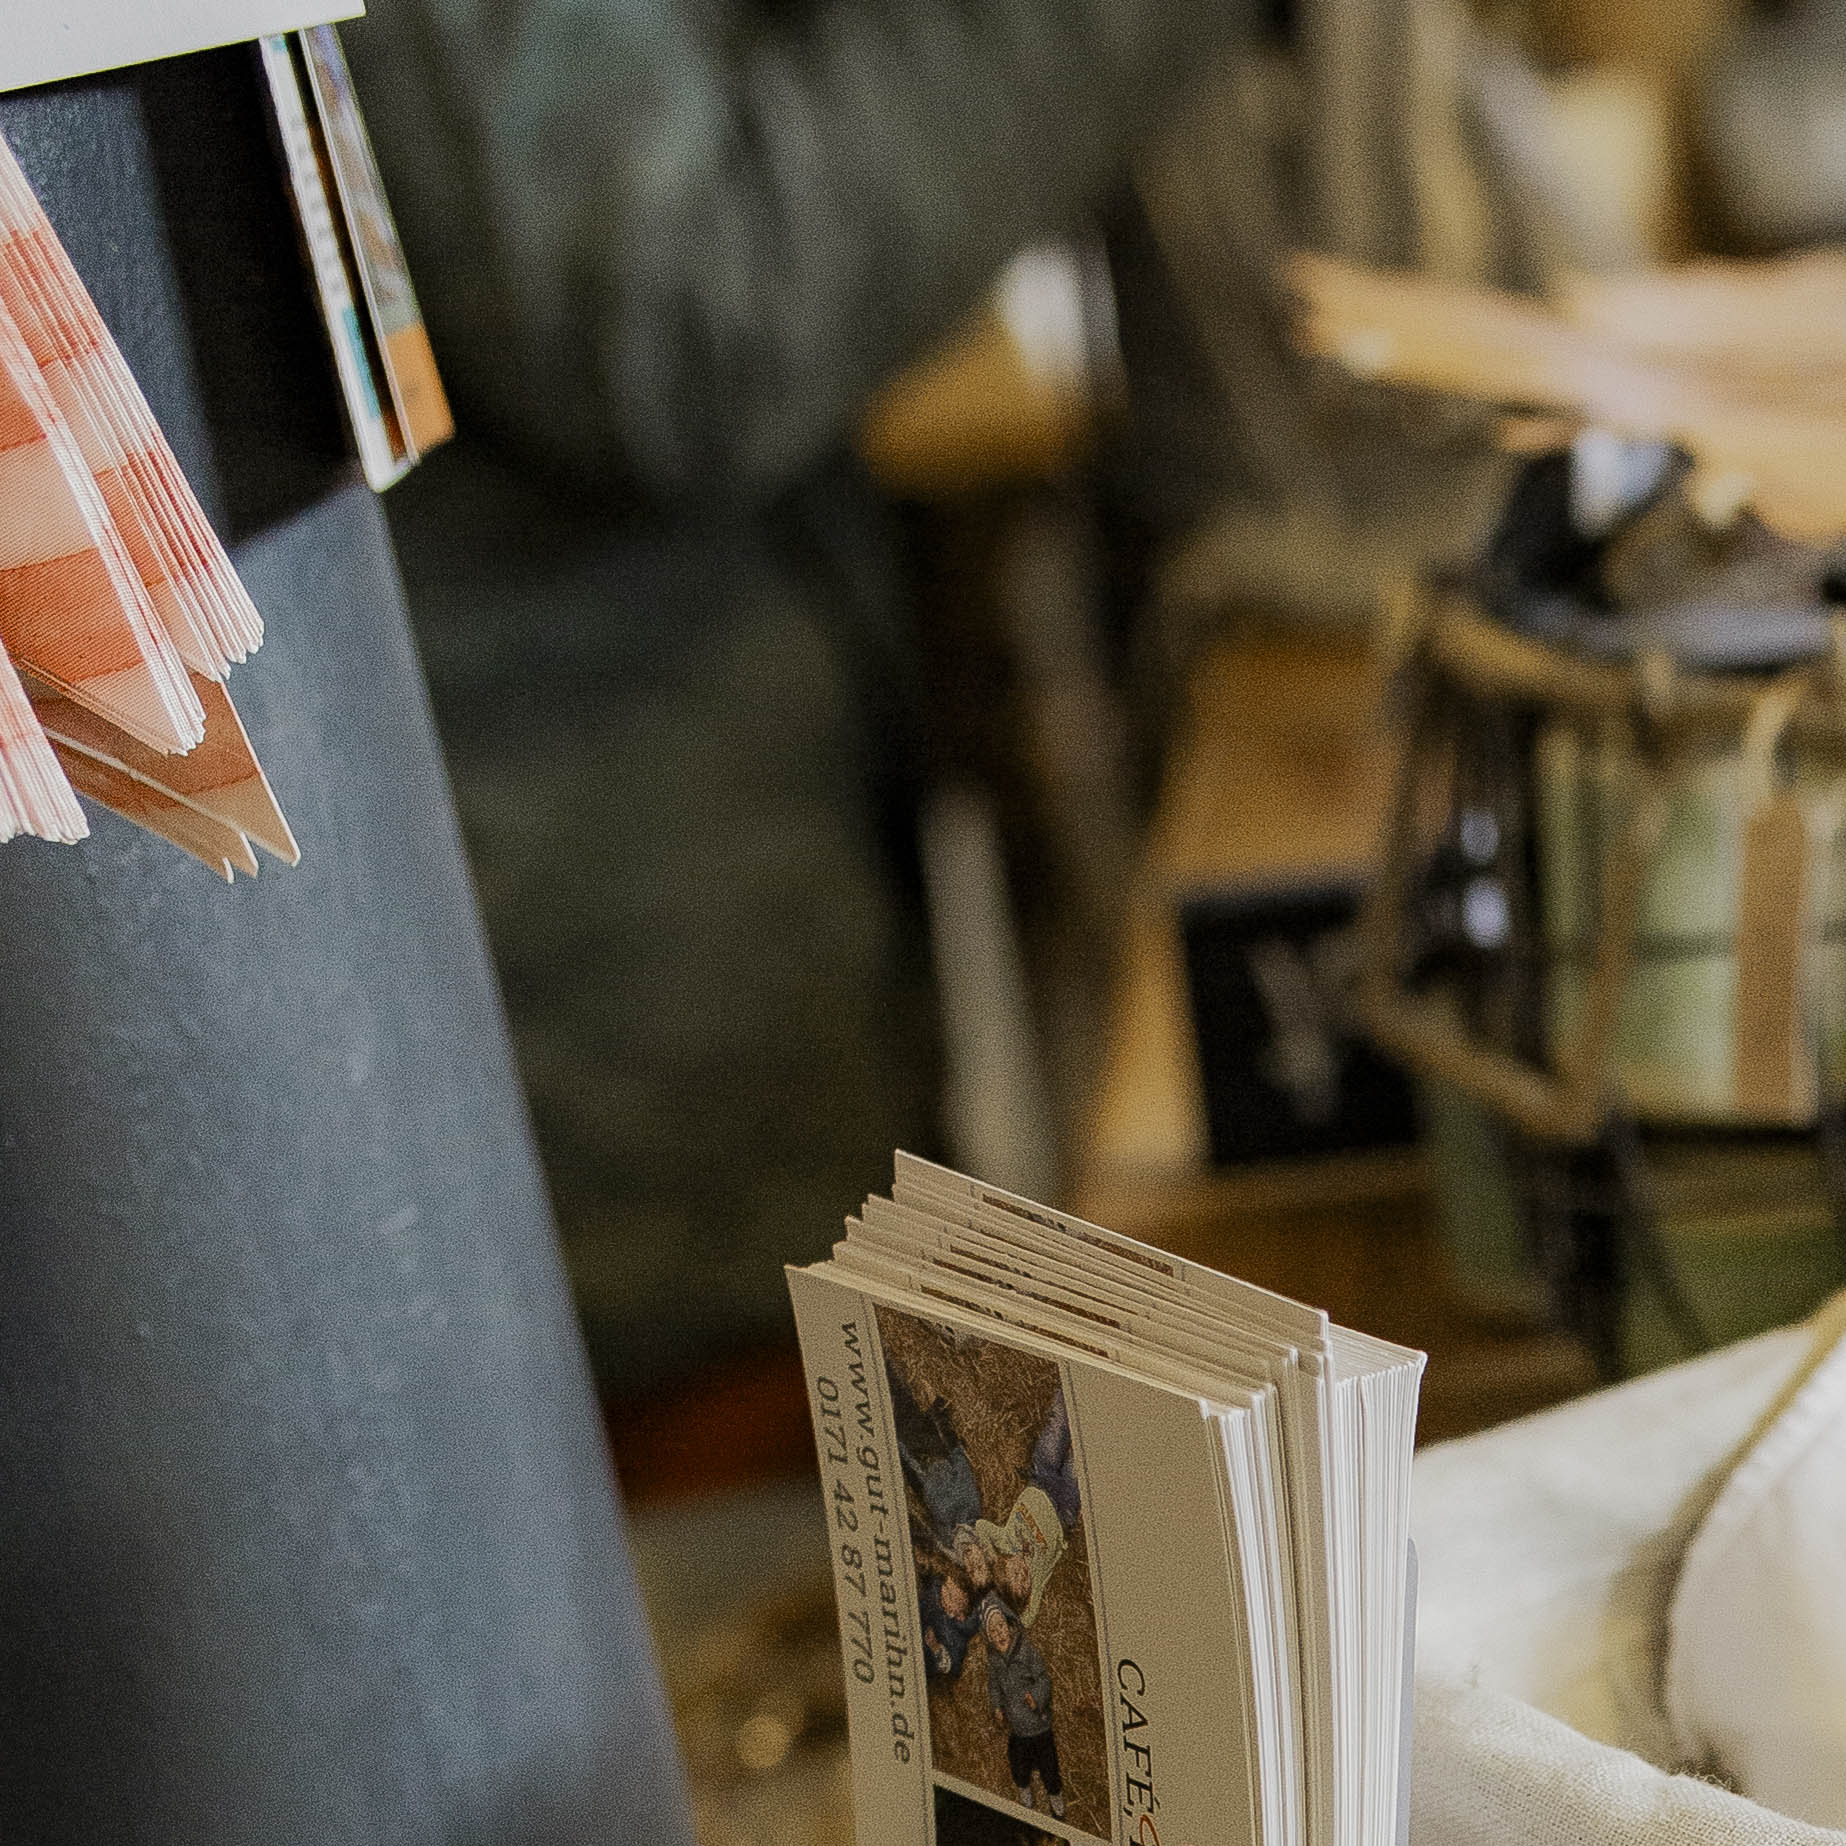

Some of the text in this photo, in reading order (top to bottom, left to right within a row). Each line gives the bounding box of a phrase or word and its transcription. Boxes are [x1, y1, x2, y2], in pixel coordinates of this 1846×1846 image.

[816, 1376, 876, 1685] 0171 42 87 770
[841, 1320, 915, 1764] www.gut-marihn.de
